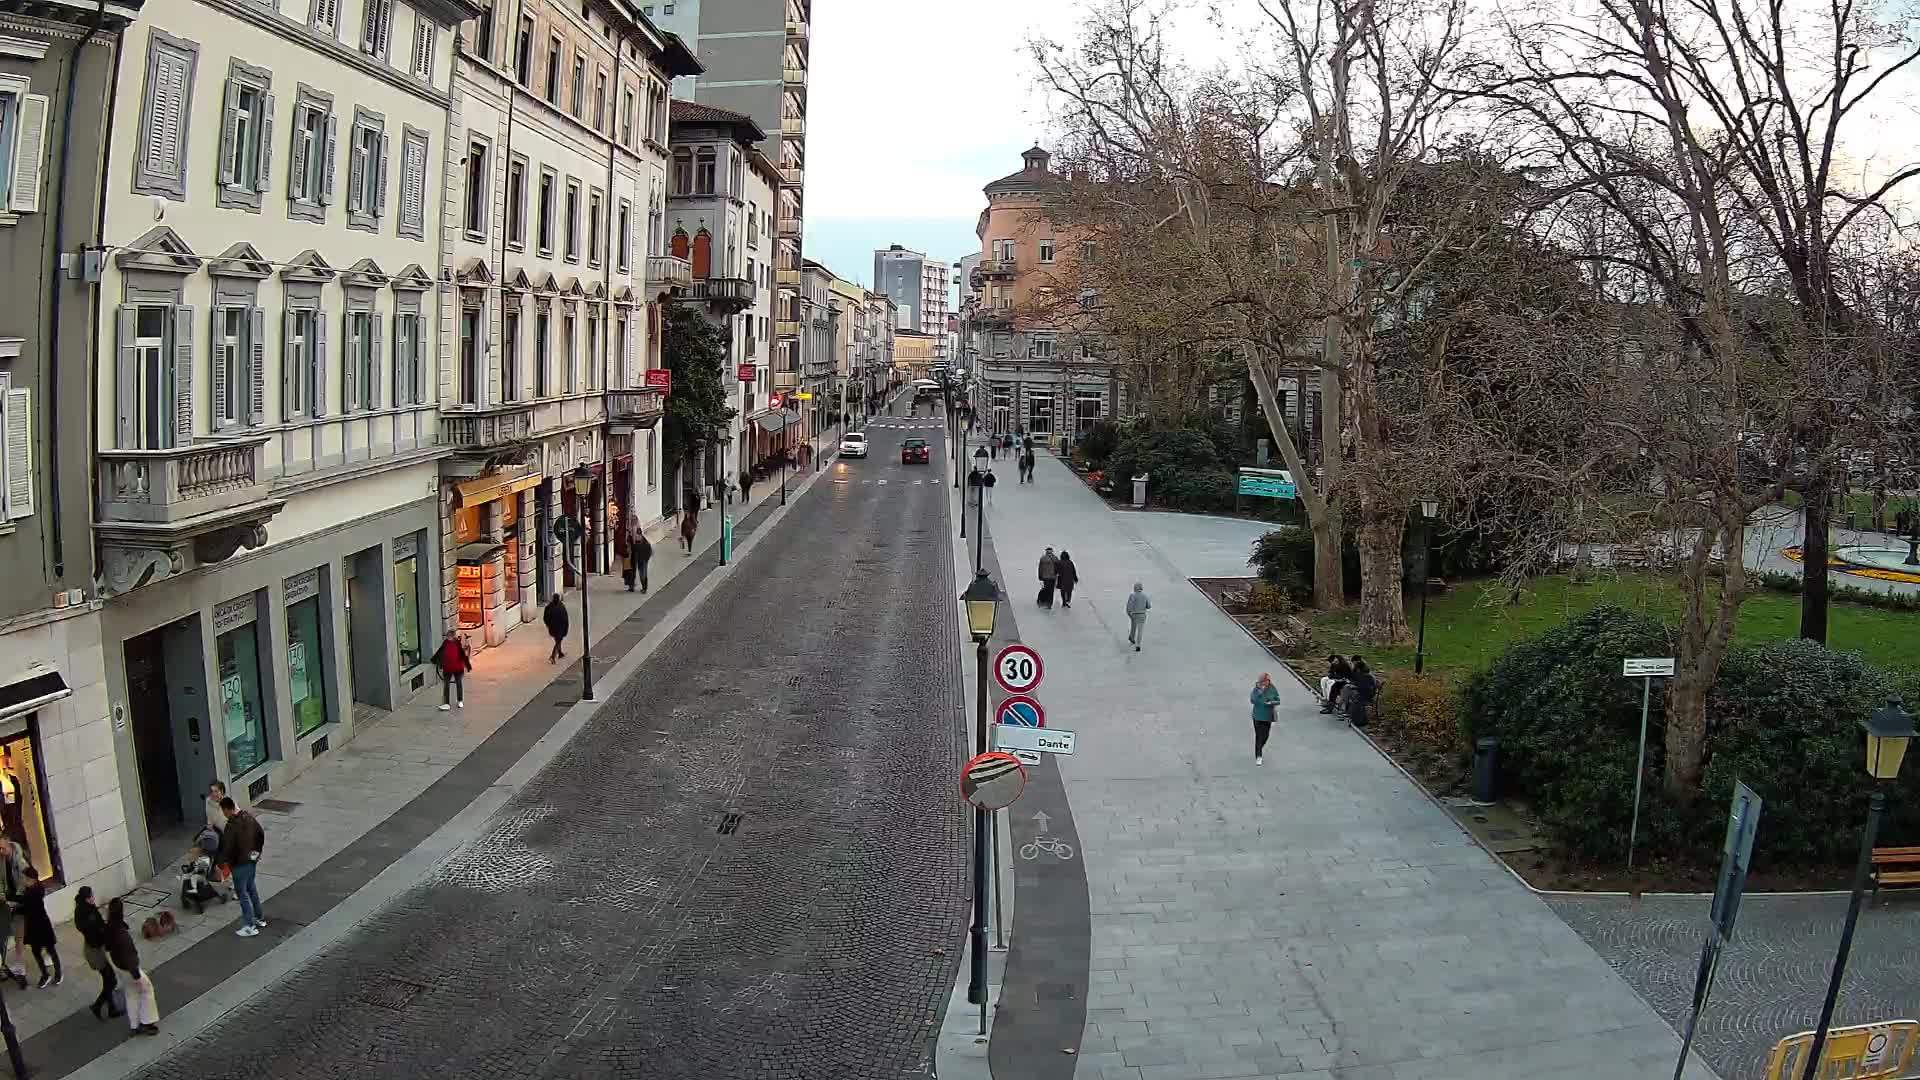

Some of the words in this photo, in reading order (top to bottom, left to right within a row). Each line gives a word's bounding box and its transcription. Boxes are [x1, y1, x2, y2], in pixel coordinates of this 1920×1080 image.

[1005, 658, 1032, 680] 30
[223, 677, 240, 700] 130
[1038, 738, 1069, 749] Dante
